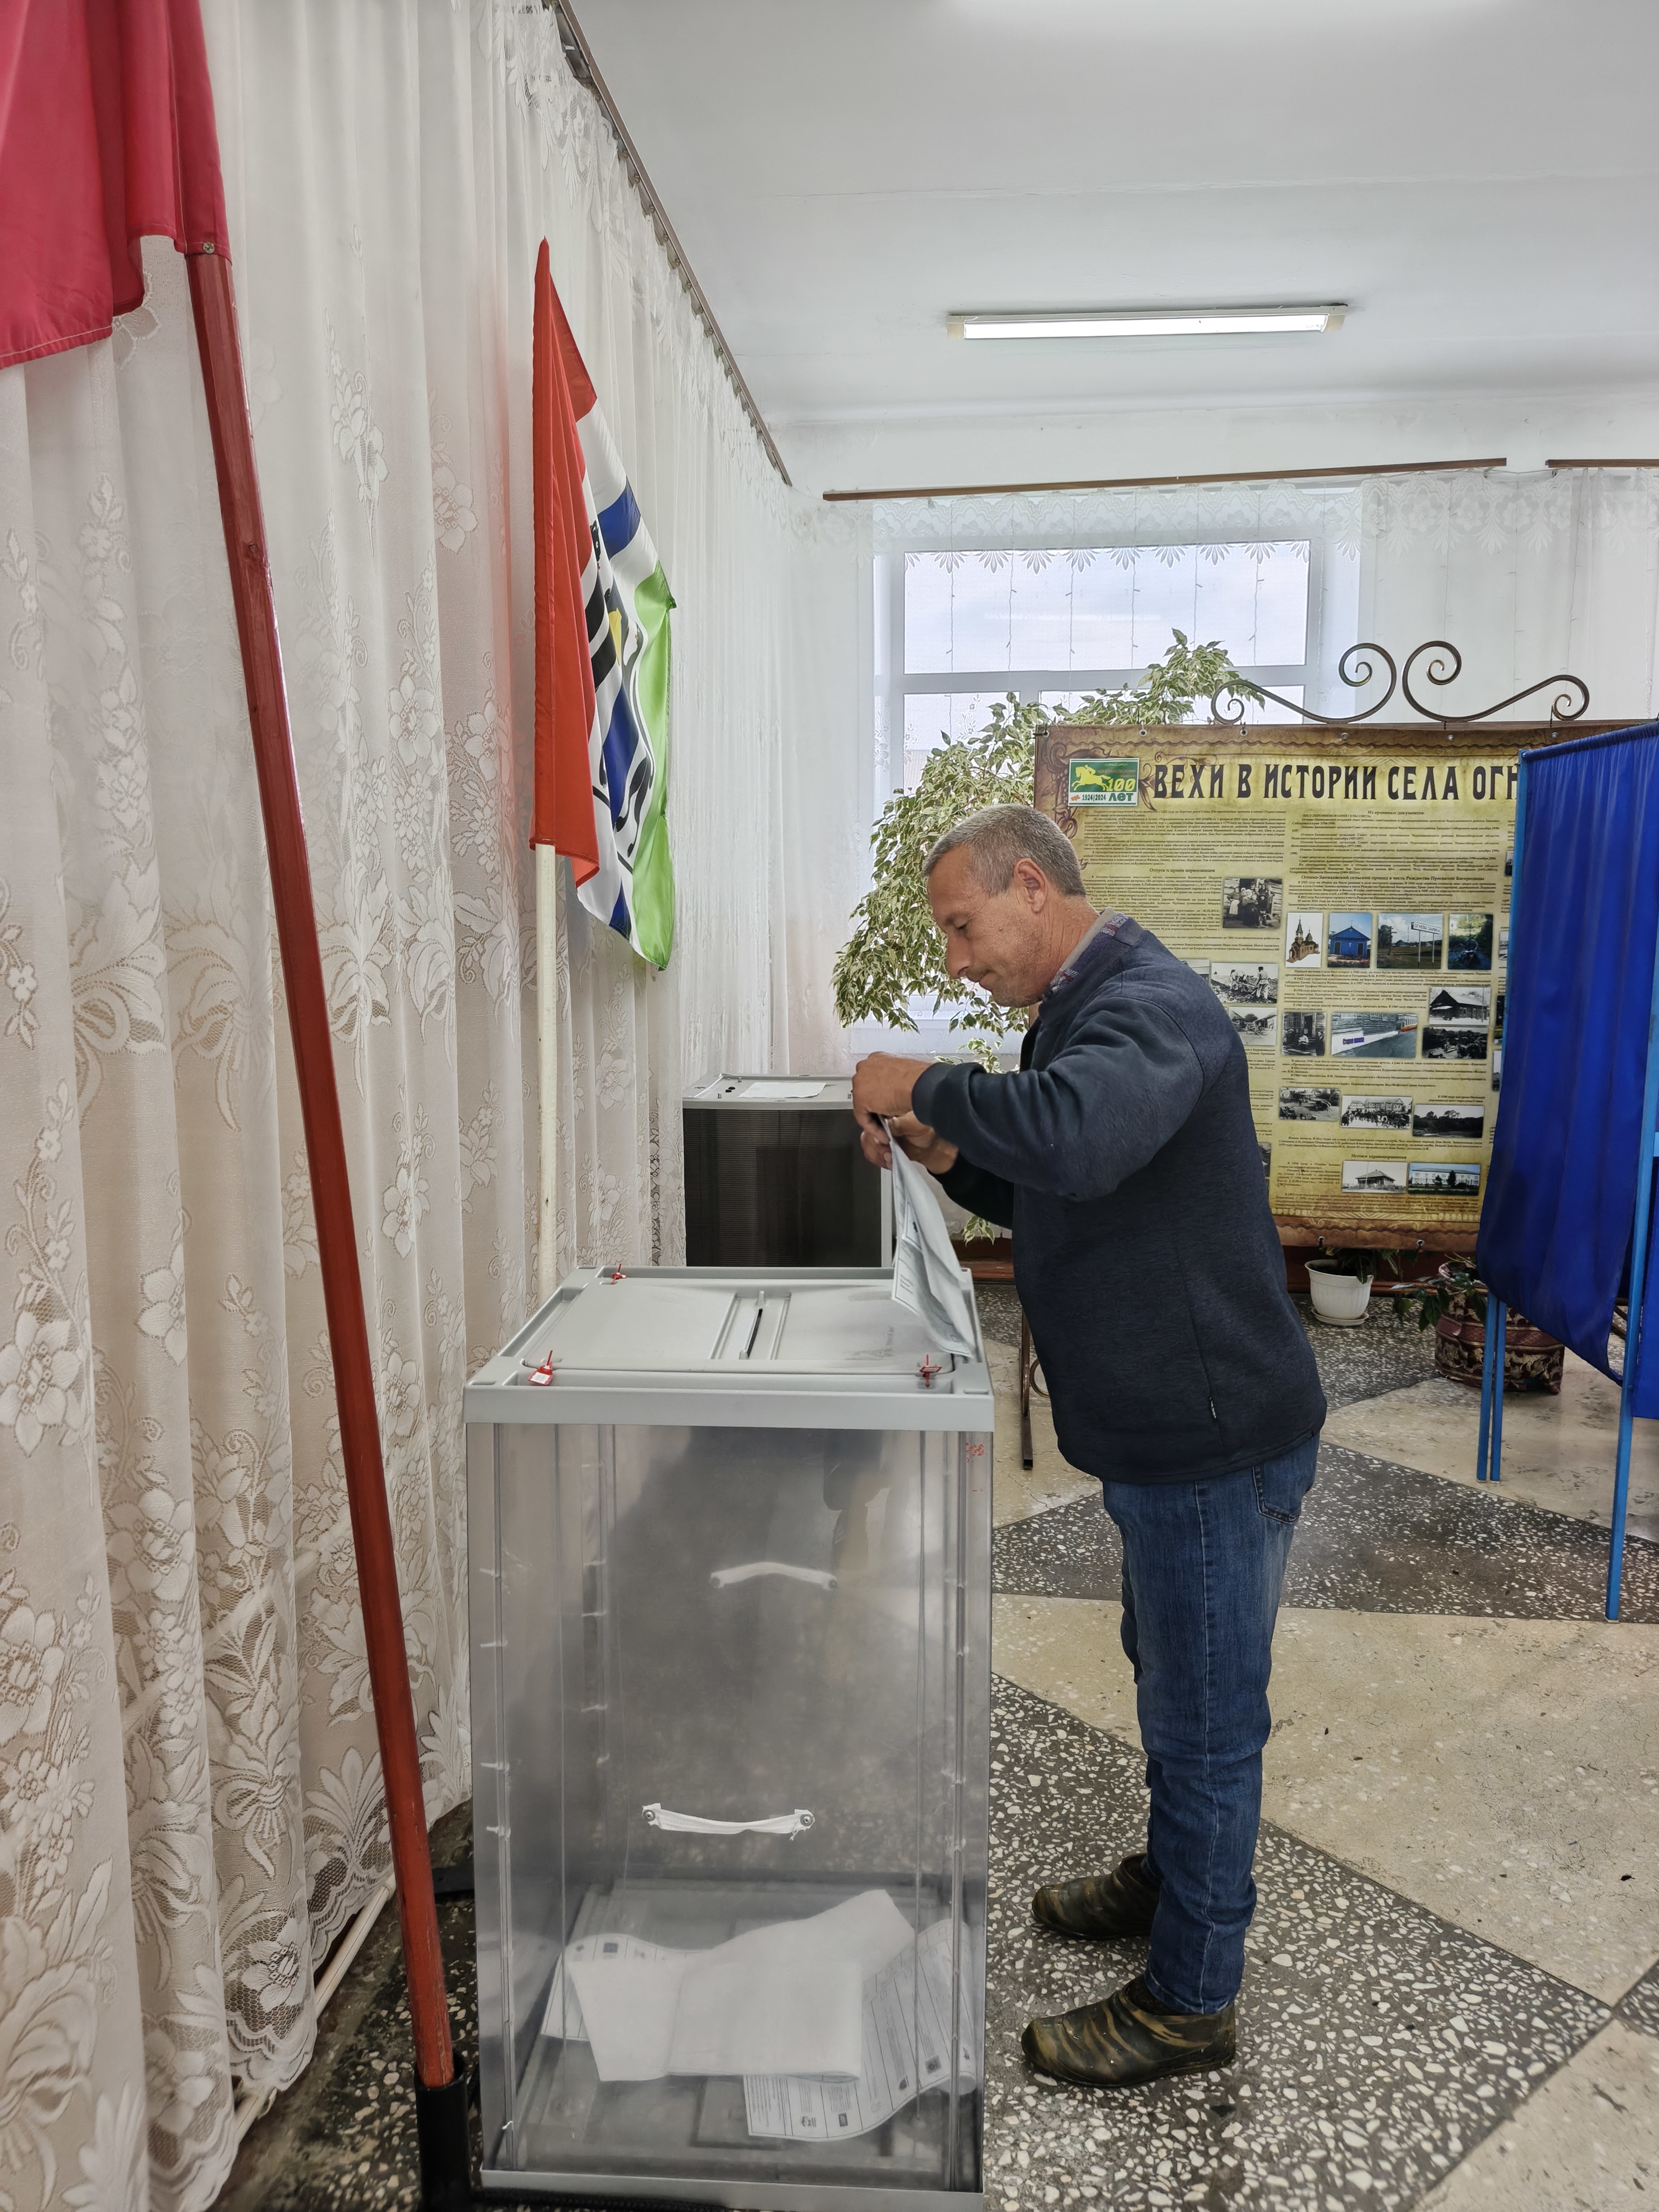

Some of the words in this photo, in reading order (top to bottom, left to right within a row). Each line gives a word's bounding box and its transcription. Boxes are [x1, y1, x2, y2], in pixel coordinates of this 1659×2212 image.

[1107, 778, 1136, 791] 100
[1152, 764, 1225, 798] ВЕХИ
[1236, 764, 1252, 798] В
[1263, 764, 1377, 800] ИСТОРИИ
[1388, 766, 1459, 800] СЕЛА
